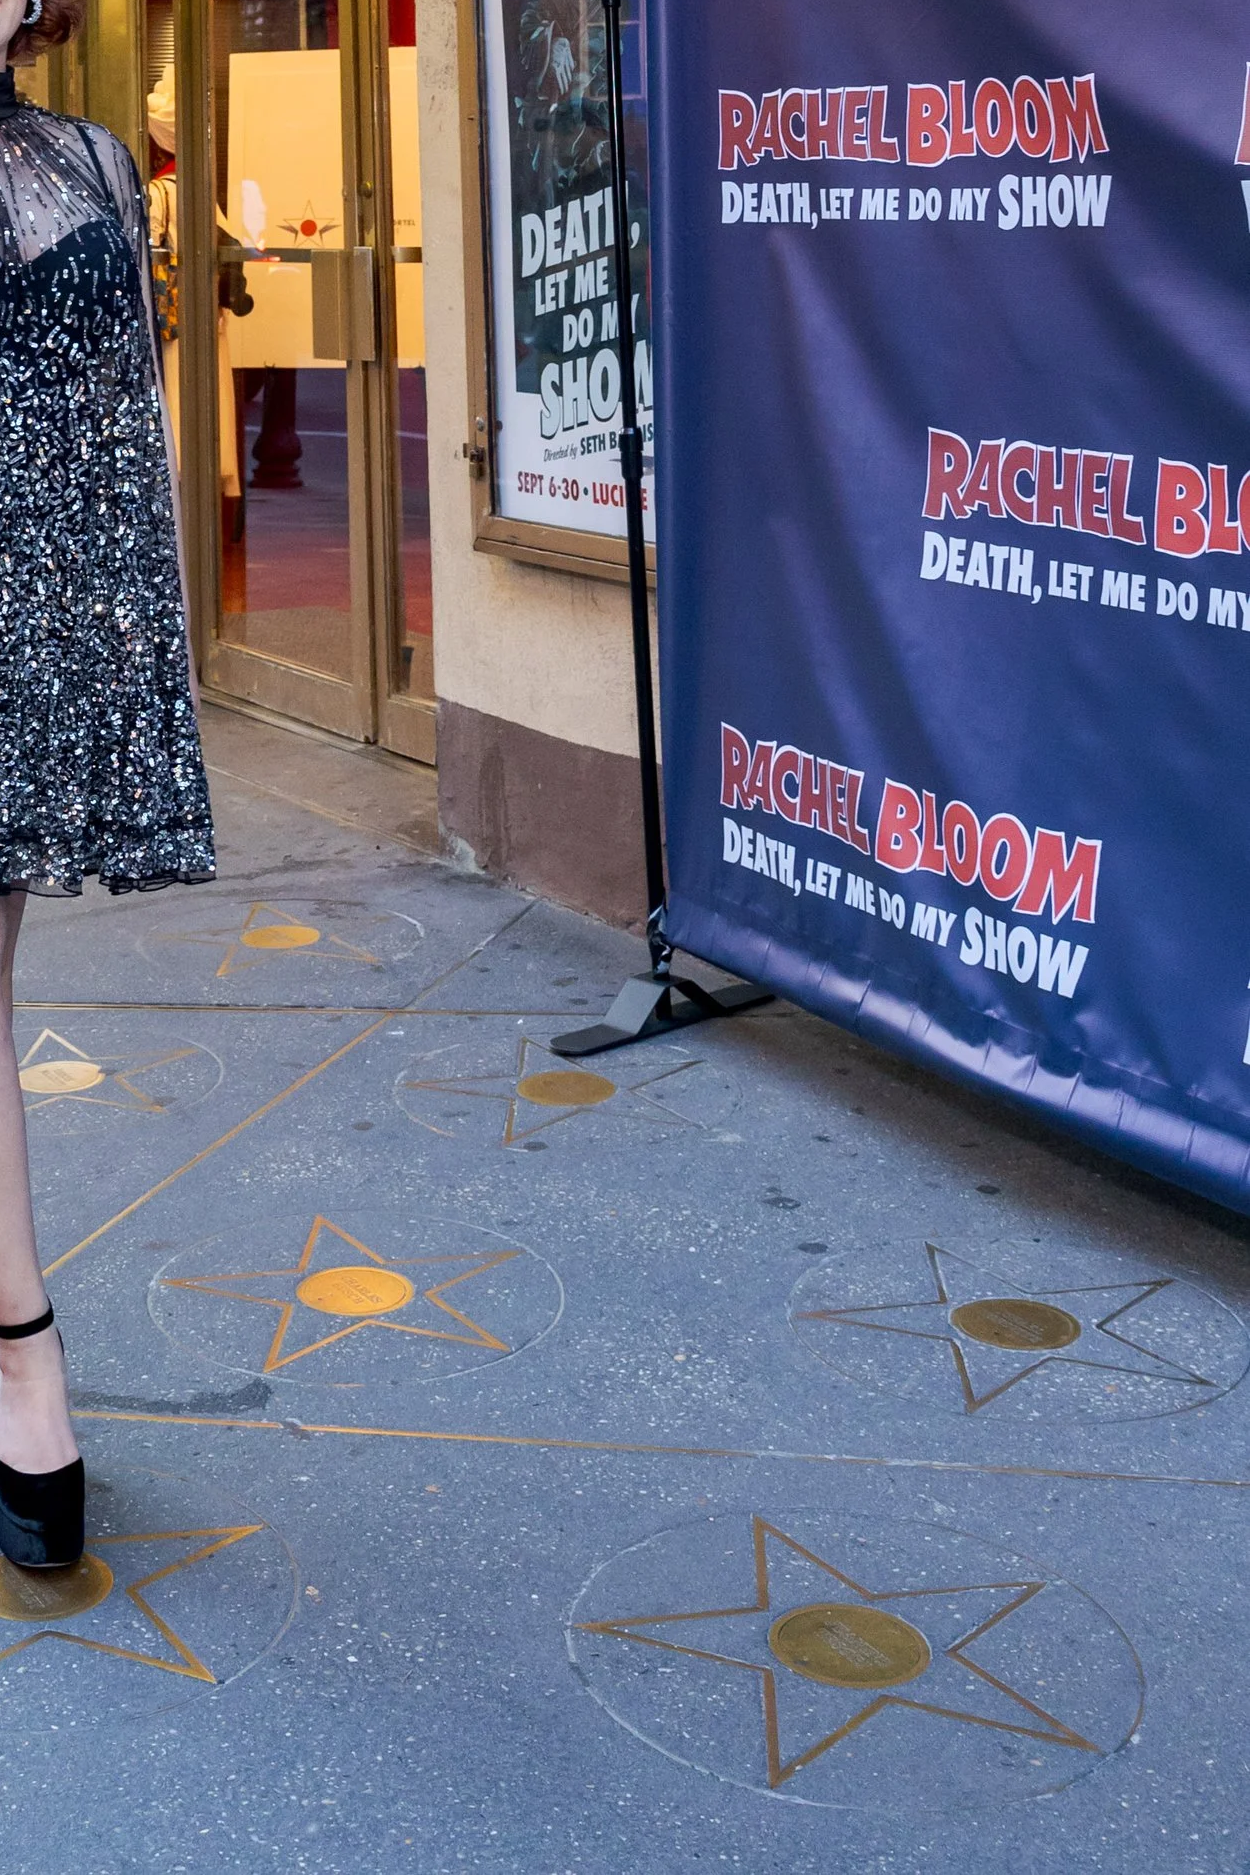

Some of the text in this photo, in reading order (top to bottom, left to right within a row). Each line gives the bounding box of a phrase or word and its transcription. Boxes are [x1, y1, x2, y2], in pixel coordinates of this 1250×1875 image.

[718, 73, 1110, 171] RACHEL BLOOM
[721, 174, 1112, 231] DEATH, LET ME DO MY SHOW
[535, 257, 608, 317] LET ME
[563, 308, 594, 353] DO
[568, 443, 578, 460] by
[580, 434, 606, 456] SETH
[517, 471, 648, 510] SEPT 6-30 LUCIE
[921, 426, 1250, 559] RACHEL BL
[919, 530, 1042, 604] DEATH,
[1047, 560, 1091, 602] LET
[1100, 569, 1146, 612] ME
[1156, 578, 1199, 621] DO
[720, 721, 1102, 925] RACHEL BLOOM
[722, 817, 1090, 998] DEATH, LET ME DO MY SHOW
